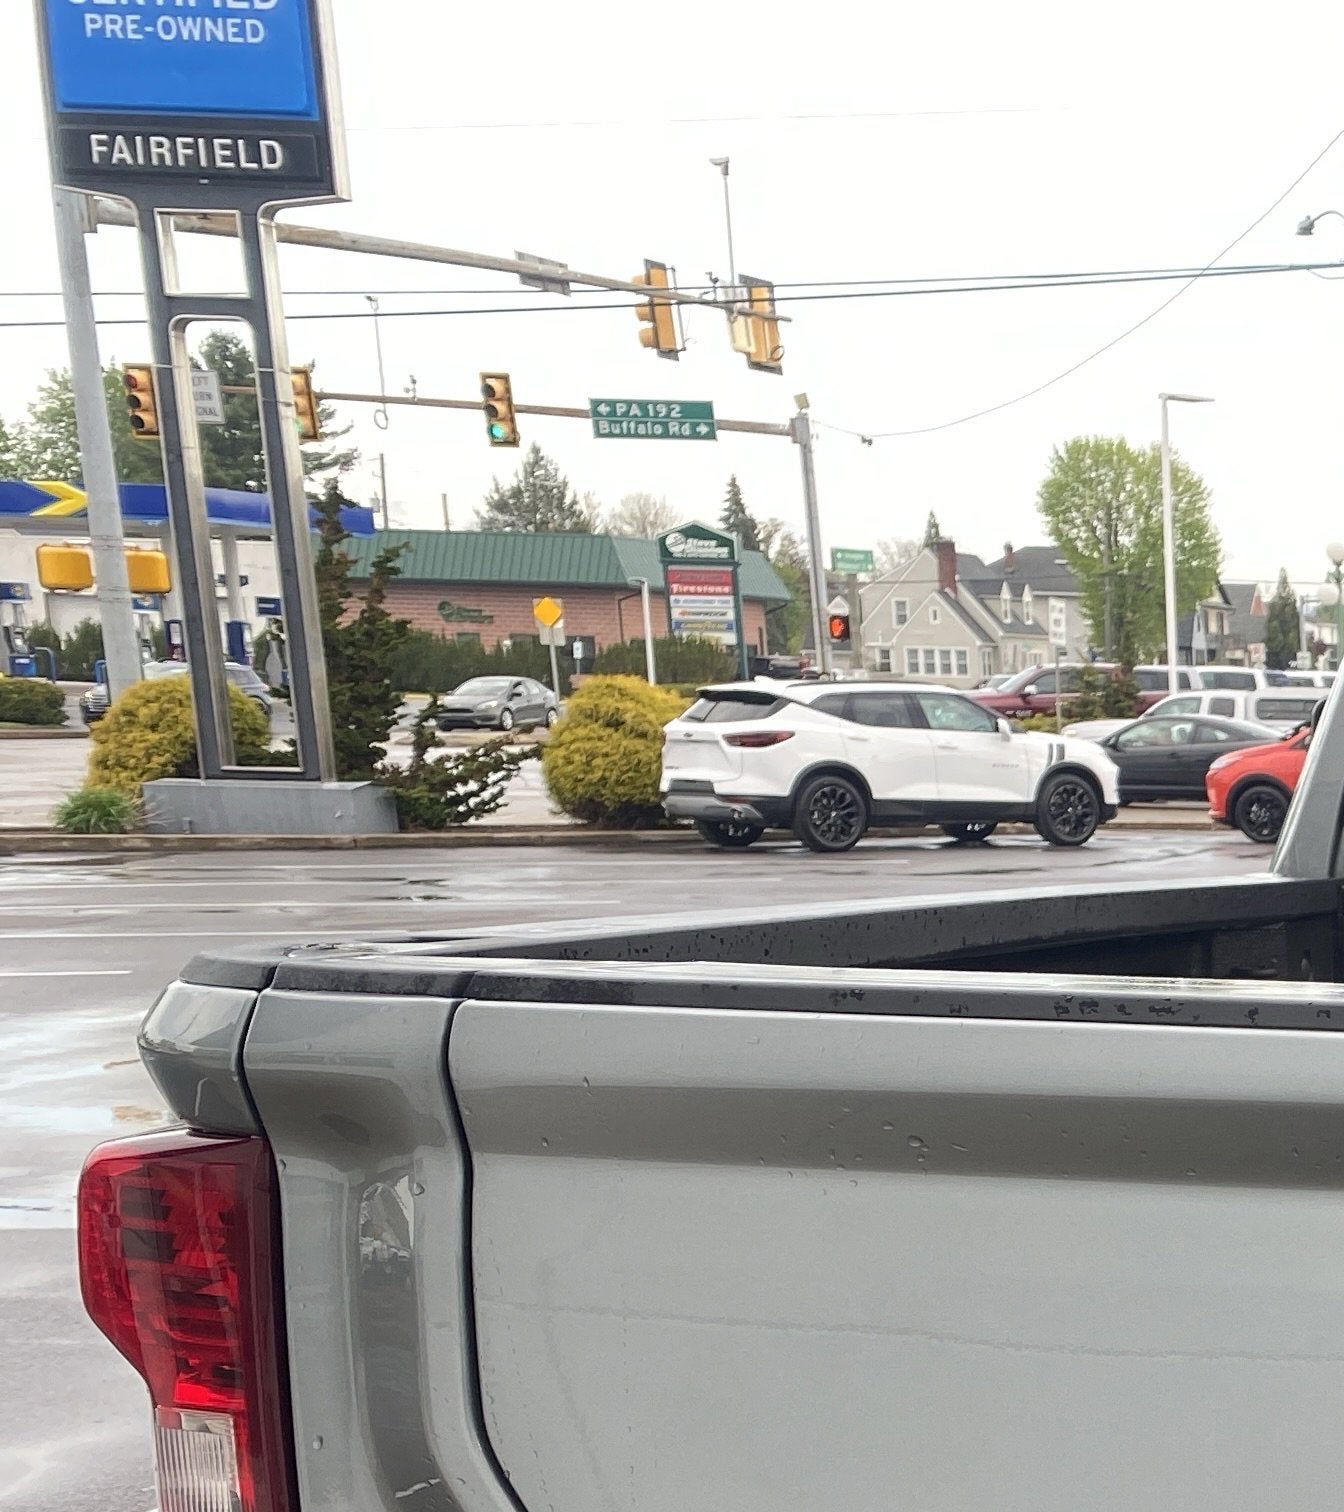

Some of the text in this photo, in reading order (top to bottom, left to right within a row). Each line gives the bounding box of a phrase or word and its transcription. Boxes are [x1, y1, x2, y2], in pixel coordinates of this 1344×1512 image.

[84, 13, 265, 44] PRE-OWNED
[89, 133, 284, 170] FAIRFIELD
[615, 402, 682, 418] PA 192
[598, 420, 691, 436] Buffalo Rd
